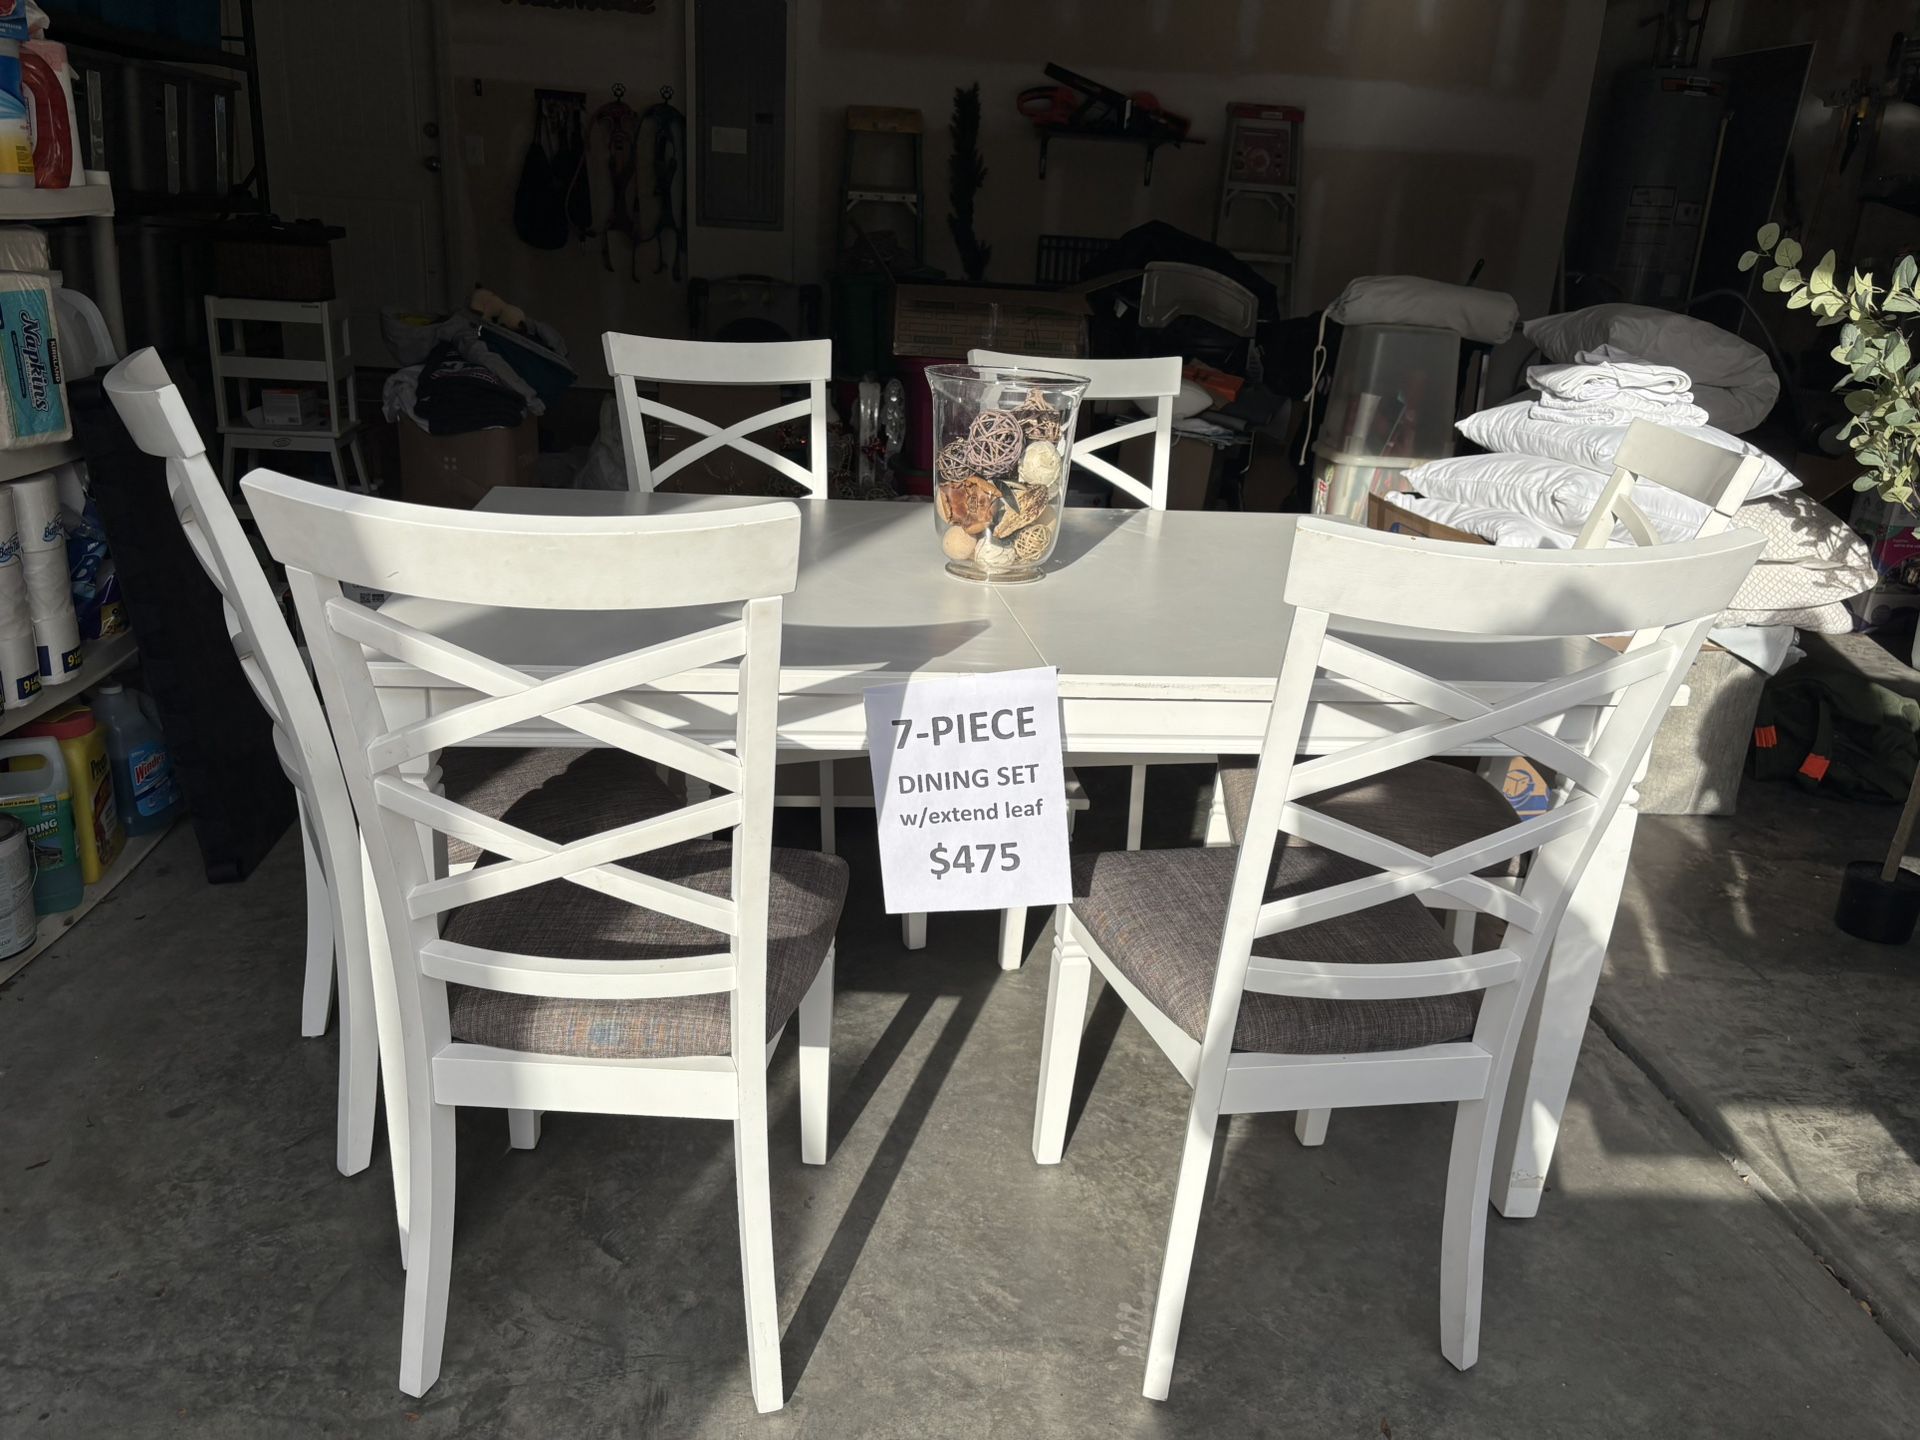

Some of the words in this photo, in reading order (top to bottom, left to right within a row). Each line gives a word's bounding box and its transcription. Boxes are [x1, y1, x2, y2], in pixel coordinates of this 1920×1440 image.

[20, 311, 48, 411] Napkins
[49, 340, 60, 383] KIRKLAND
[891, 706, 1037, 750] 7-PIECE
[898, 768, 990, 795] DINING
[997, 763, 1040, 787] SET
[899, 802, 999, 829] w/extend
[1005, 798, 1044, 819] leaf
[929, 841, 1021, 880] $475
